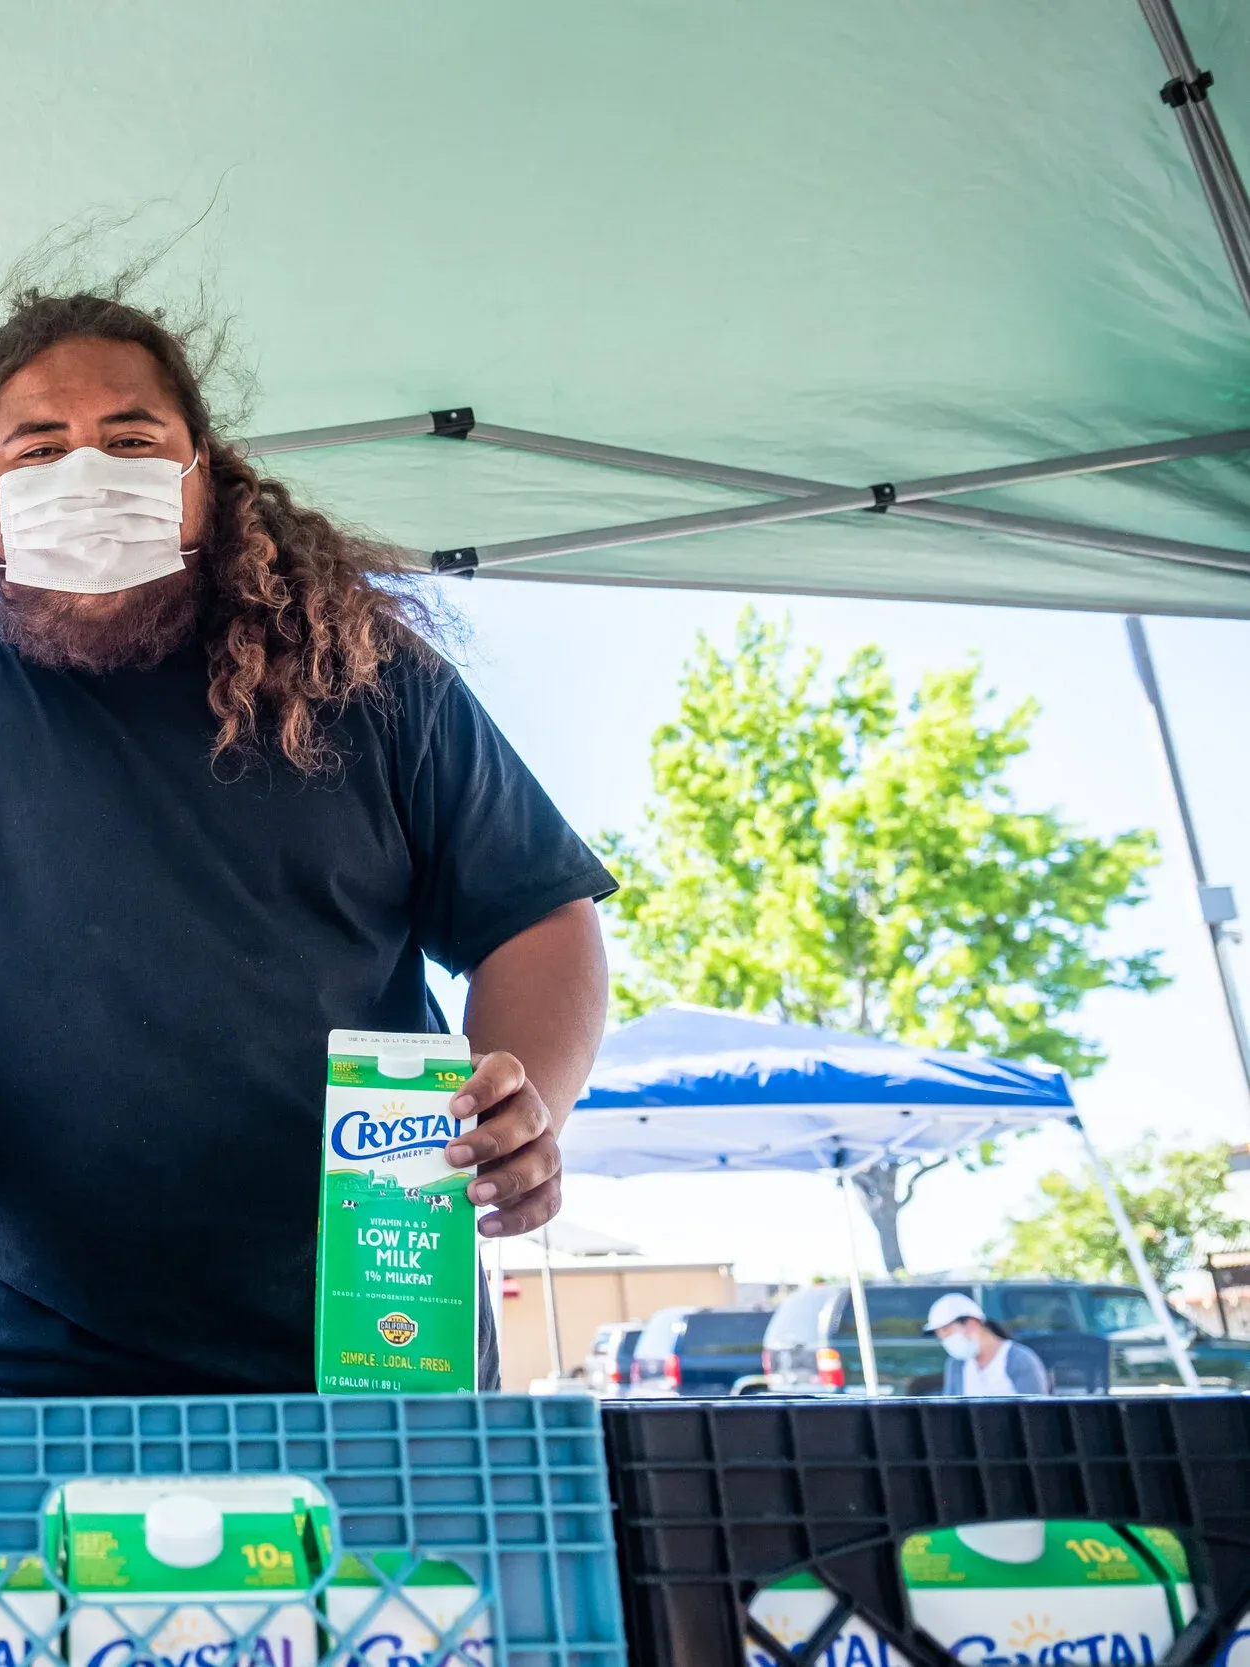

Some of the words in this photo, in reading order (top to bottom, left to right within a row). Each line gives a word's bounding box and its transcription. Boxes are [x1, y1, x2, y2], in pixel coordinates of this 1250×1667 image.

[381, 1149, 423, 1163] CREAMERY
[370, 1217, 402, 1227] VITAMIN
[421, 1221, 427, 1229] D
[357, 1228, 400, 1247] LOW
[408, 1231, 441, 1250] FAT
[376, 1248, 421, 1269] MILK
[365, 1270, 381, 1282] 1%
[385, 1271, 433, 1286] MILKFAT
[365, 1292, 415, 1301] HOMOGENIZED
[419, 1296, 463, 1305] PASTEURIZED
[380, 1321, 414, 1332] CALIFORNIA
[341, 1351, 379, 1366] SIMPLE.
[383, 1355, 416, 1369] LOCAL.
[419, 1357, 454, 1372] FRESH.
[325, 1376, 336, 1386] 1/2
[339, 1376, 370, 1388] GALLON
[371, 1379, 391, 1390] (1.89
[393, 1380, 401, 1391] L)
